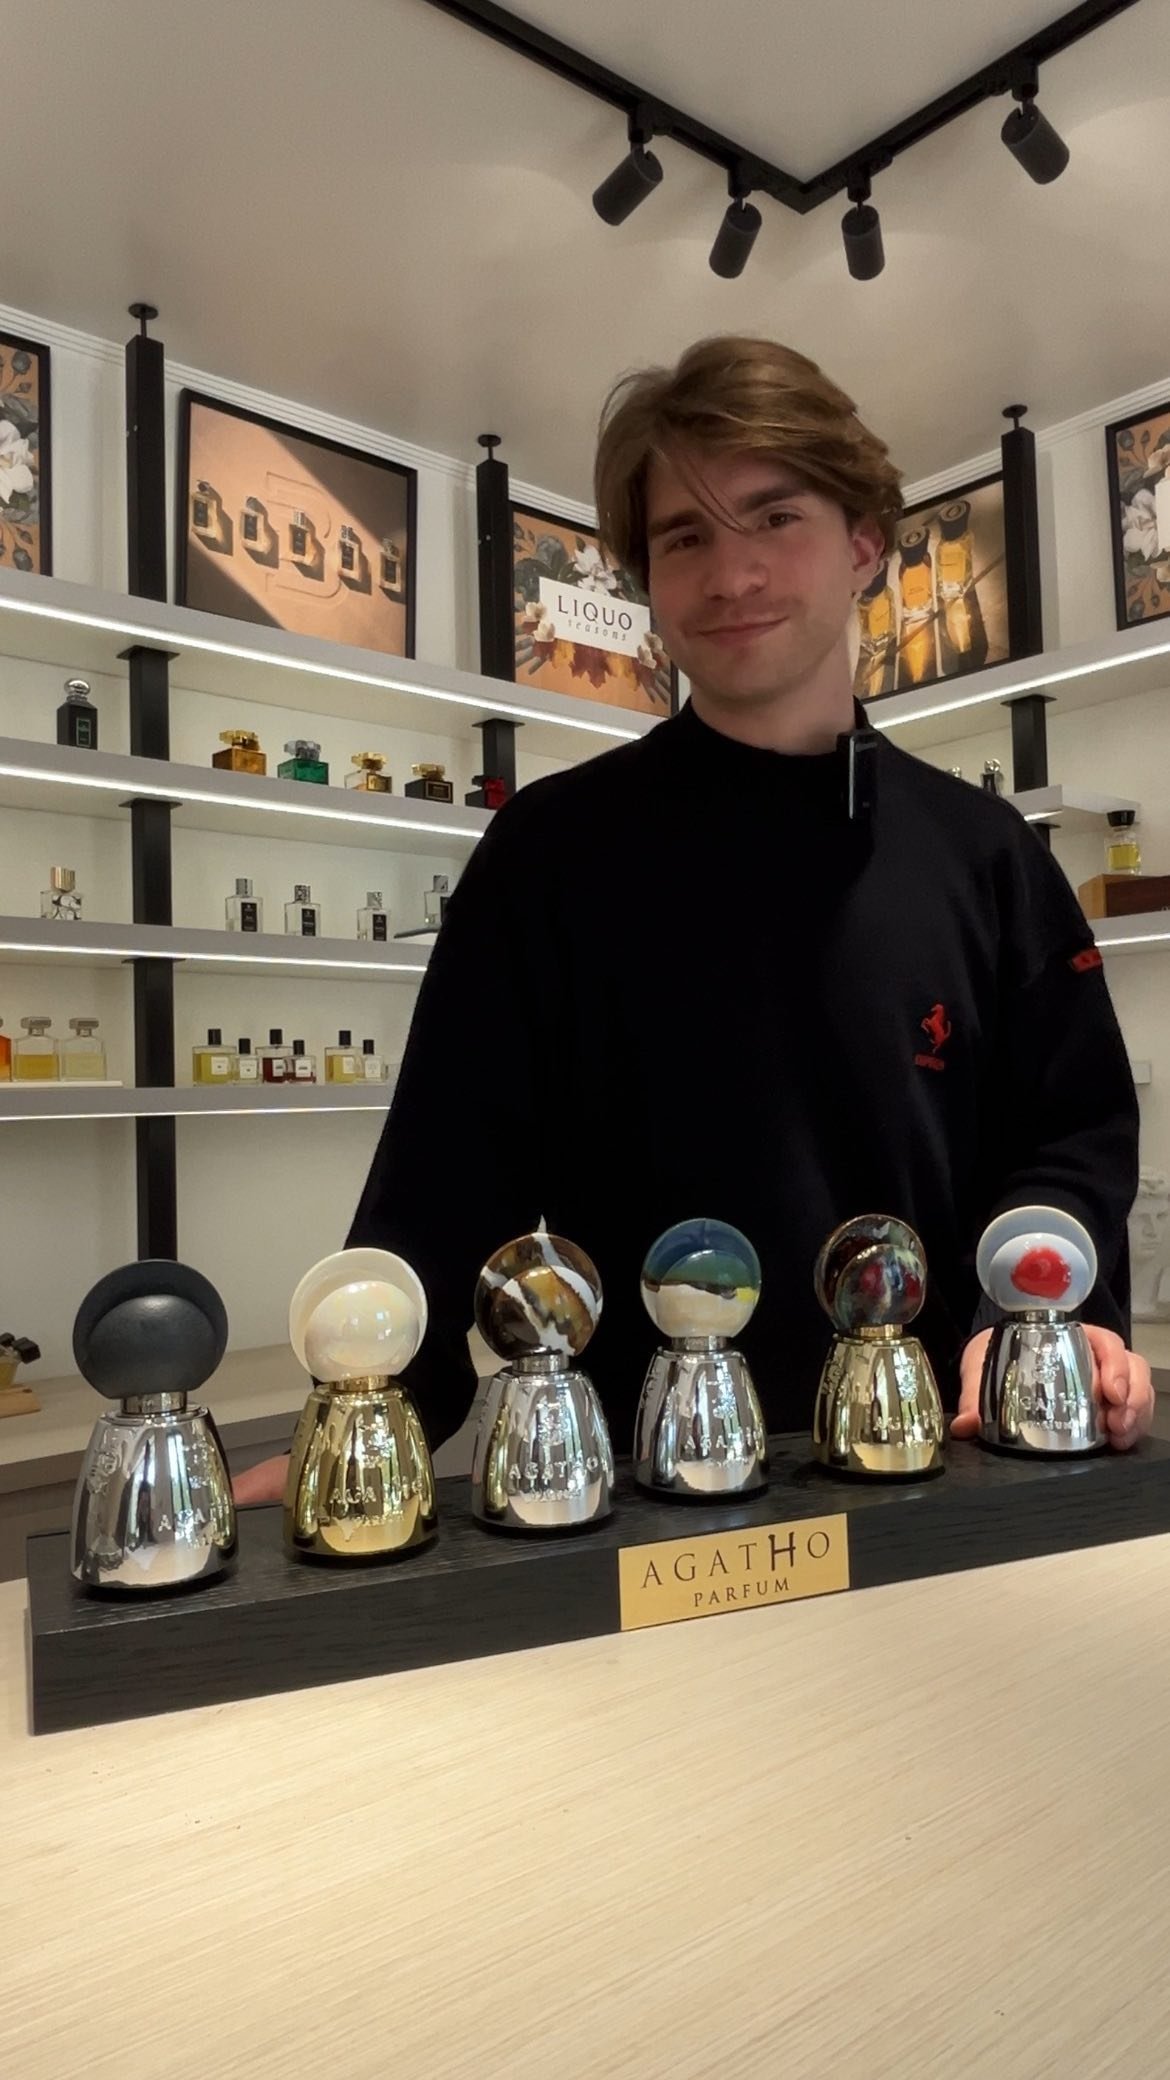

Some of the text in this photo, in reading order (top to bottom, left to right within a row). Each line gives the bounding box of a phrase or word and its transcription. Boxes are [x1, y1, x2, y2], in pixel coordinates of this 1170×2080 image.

[558, 595, 632, 630] LIQUO
[568, 619, 627, 641] seasons
[640, 1531, 830, 1589] AGATHO
[693, 1577, 790, 1608] PARFUM
